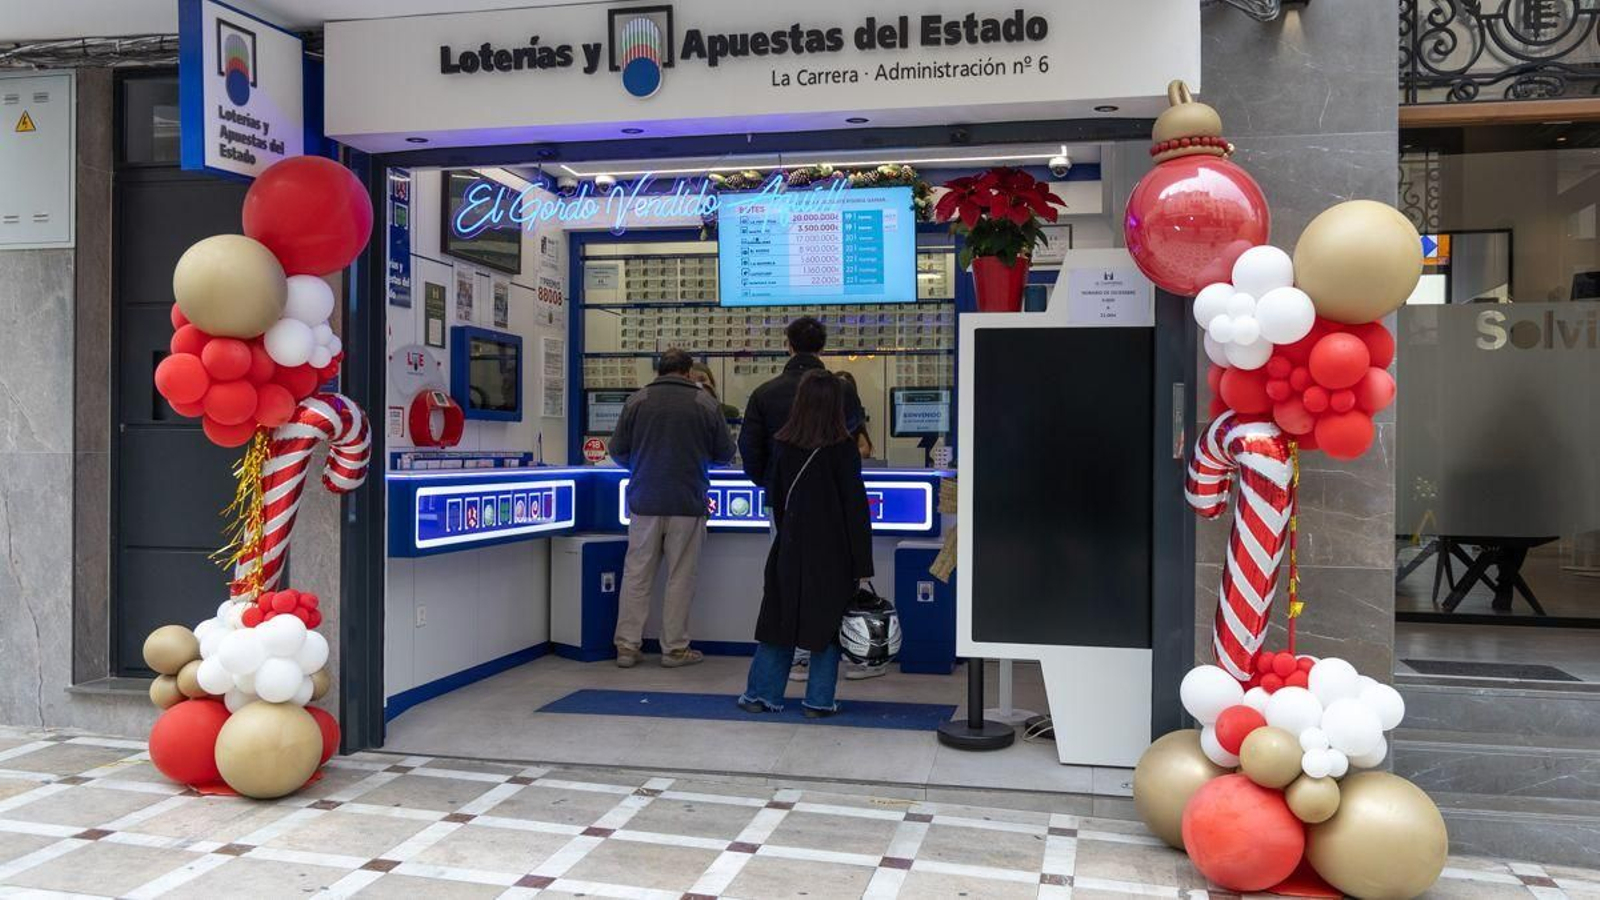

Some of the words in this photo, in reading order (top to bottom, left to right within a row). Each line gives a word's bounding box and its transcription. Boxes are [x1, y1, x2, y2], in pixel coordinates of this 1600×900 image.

[440, 35, 573, 74] Loterías
[581, 42, 601, 75] y
[680, 28, 844, 67] Apuestas
[854, 16, 909, 50] del
[920, 9, 1049, 47] Estado
[772, 70, 790, 87] La
[797, 69, 858, 85] Carrera
[875, 57, 1006, 81] Administración
[1038, 55, 1049, 73] 6
[218, 104, 261, 130] Loterías
[262, 121, 269, 136] y
[219, 125, 268, 150] Apuestas
[269, 138, 284, 155] del
[219, 143, 256, 165] Estado
[456, 183, 505, 233] El
[508, 183, 598, 231] Gordo
[606, 172, 723, 231] Vendido
